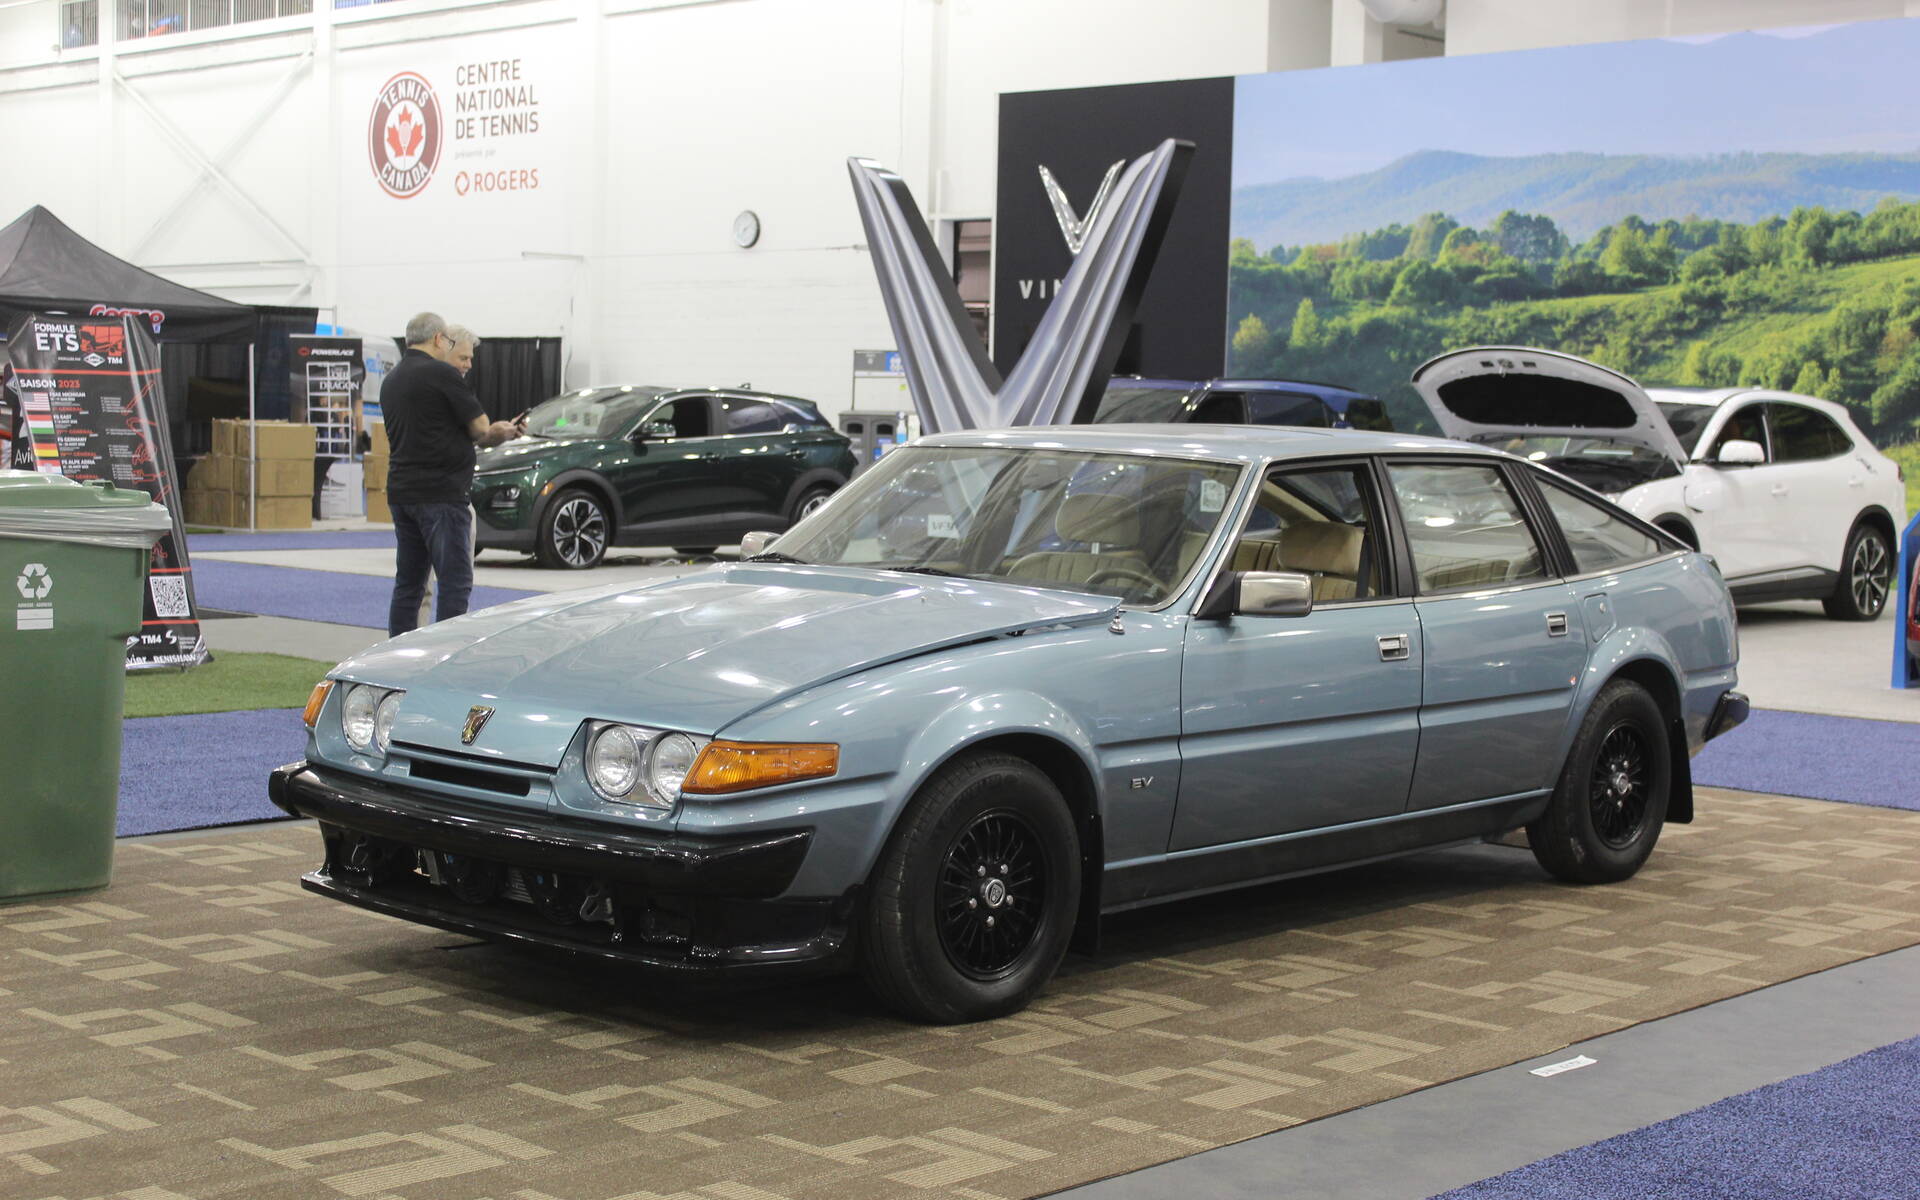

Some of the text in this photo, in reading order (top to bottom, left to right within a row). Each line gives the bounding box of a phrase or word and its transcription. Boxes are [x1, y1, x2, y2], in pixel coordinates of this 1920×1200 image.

[456, 59, 521, 86] CENTRE
[384, 79, 429, 110] TENNIS
[456, 84, 539, 113] NATIONAL
[456, 112, 539, 140] DE TENNIS
[381, 161, 428, 190] CANADA
[474, 168, 538, 192] ROGERS
[34, 323, 76, 334] FORMULE
[36, 332, 80, 352] ETS
[107, 356, 123, 364] TM4
[20, 379, 81, 389] SAISON 2023
[319, 381, 360, 391] DRAGON
[140, 634, 162, 645] TM4
[153, 654, 196, 664] RENISHAW
[1131, 776, 1154, 789] EV
